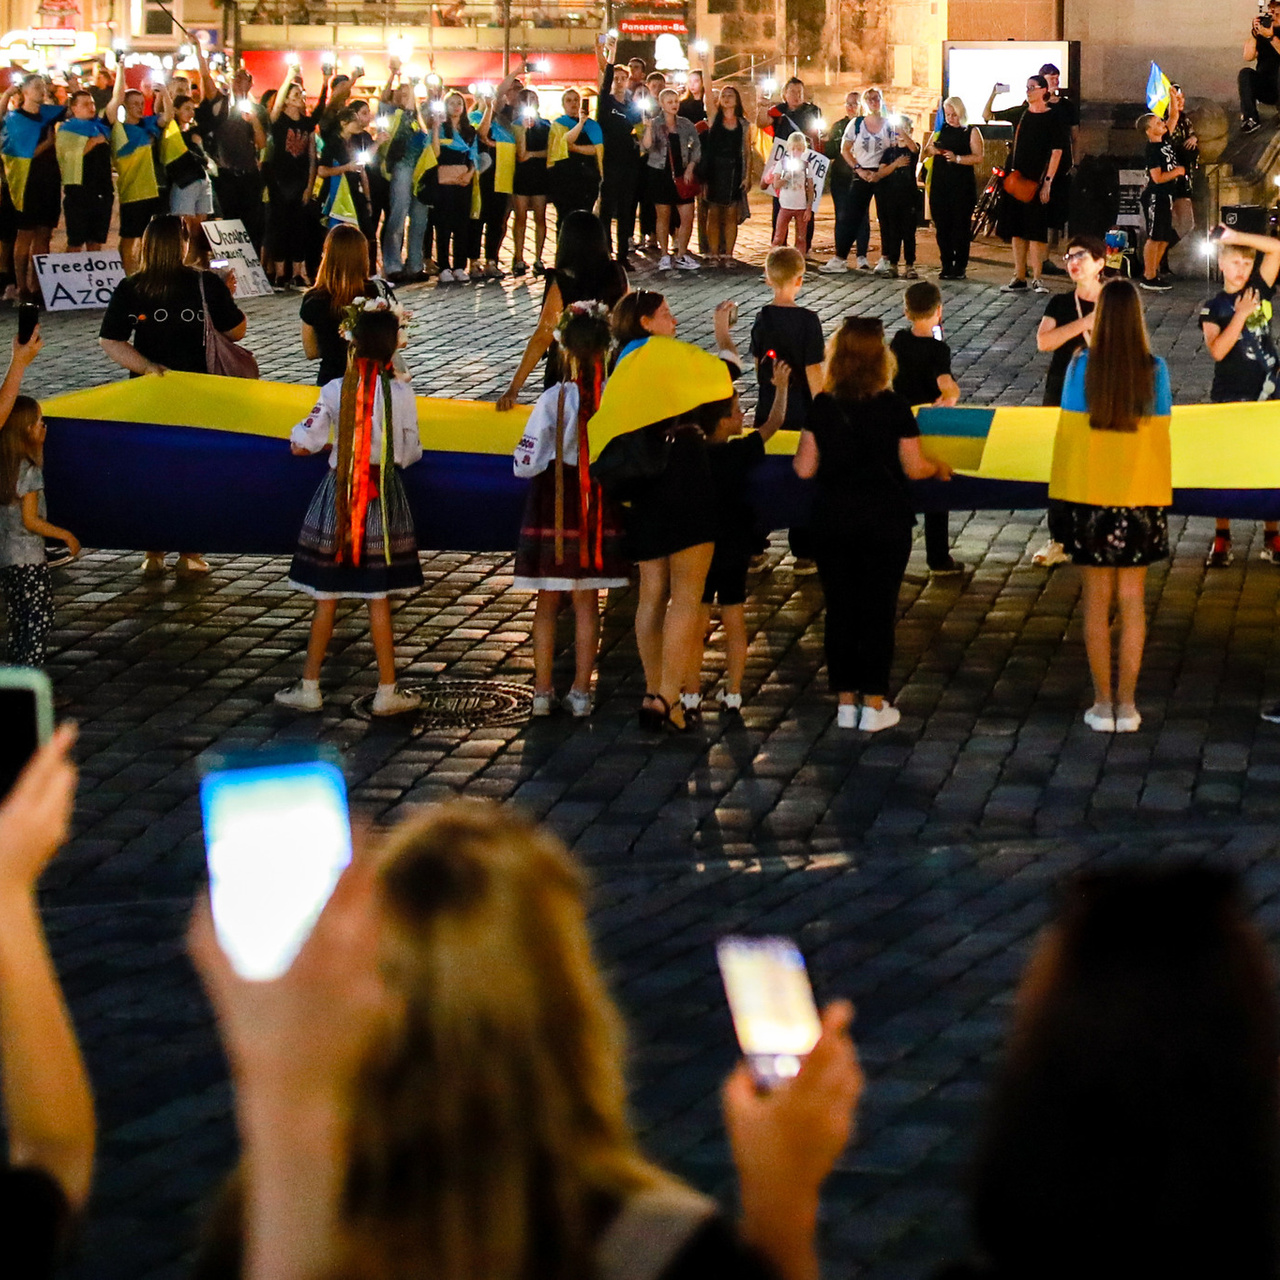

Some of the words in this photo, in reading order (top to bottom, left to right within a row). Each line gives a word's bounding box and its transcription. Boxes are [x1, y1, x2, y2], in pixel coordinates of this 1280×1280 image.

[35, 255, 122, 275] Freedom
[88, 273, 114, 287] for
[50, 282, 116, 307] Azo
